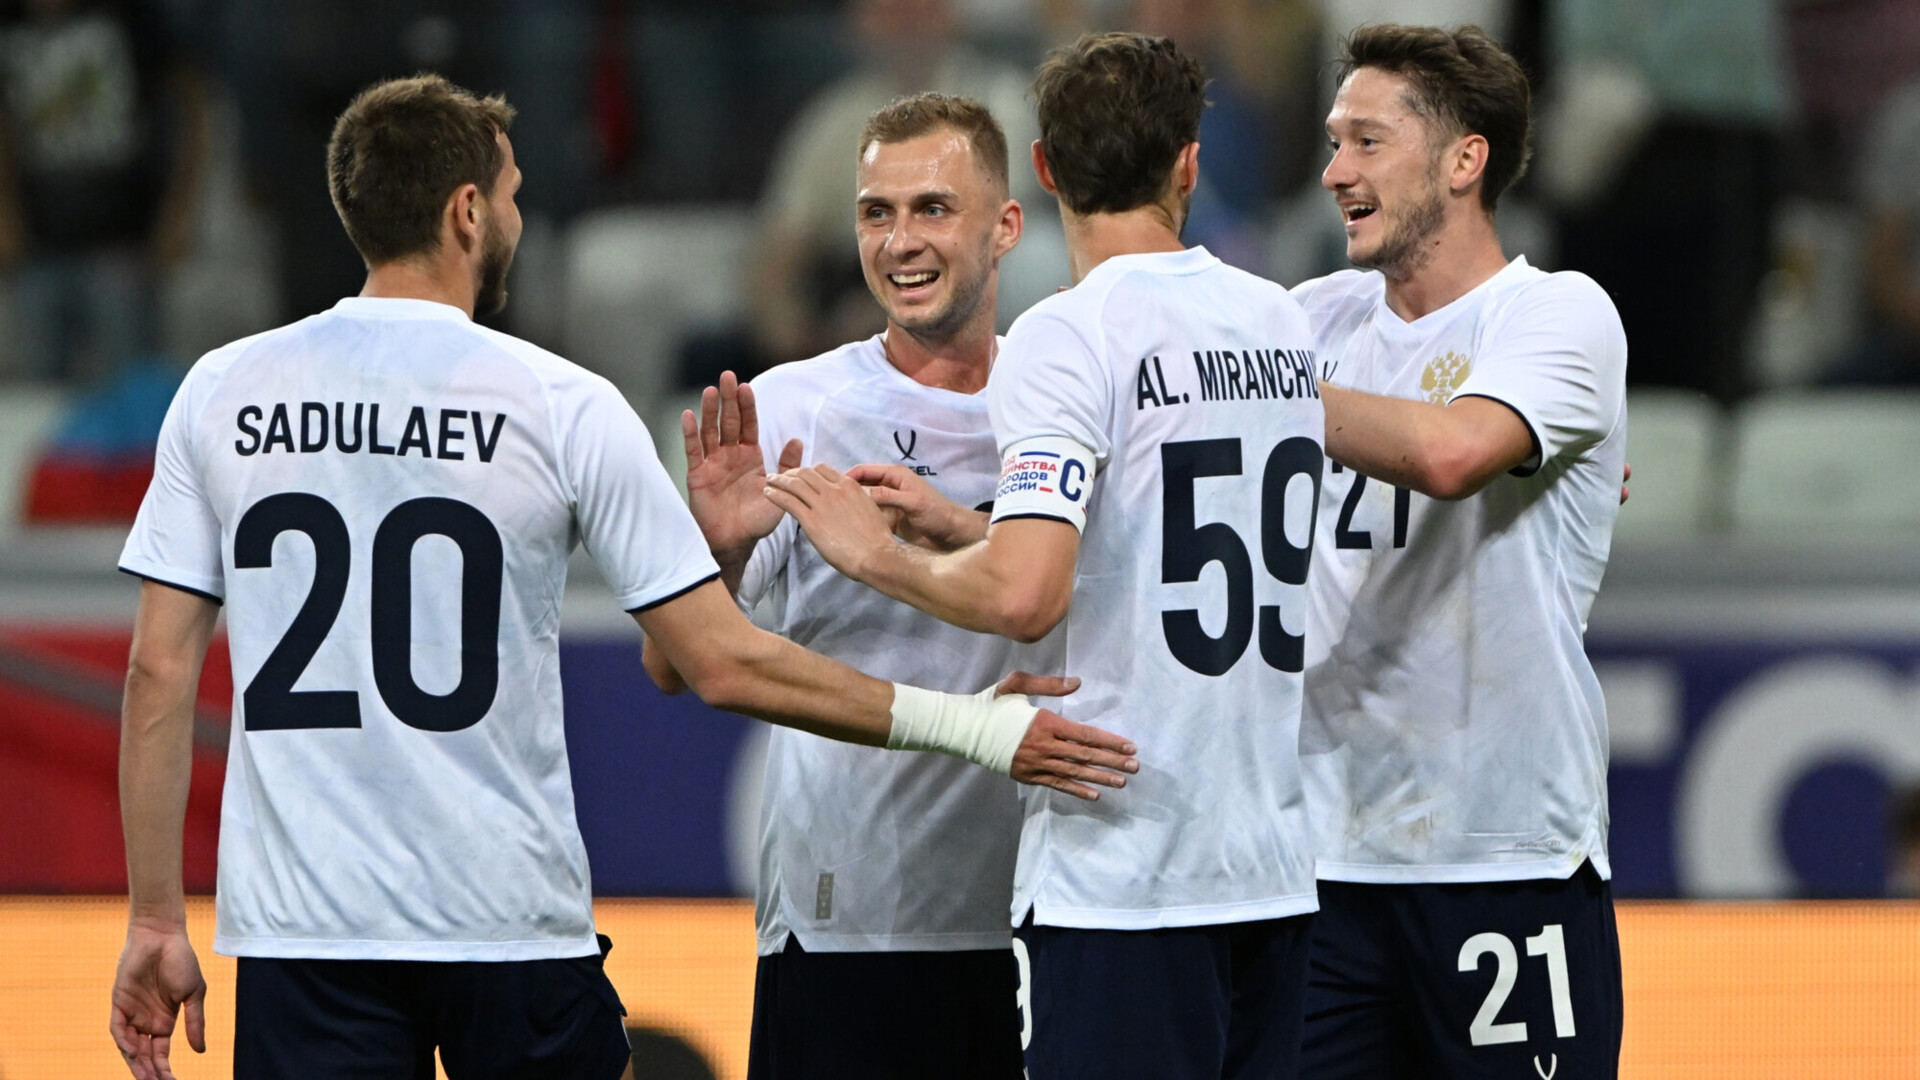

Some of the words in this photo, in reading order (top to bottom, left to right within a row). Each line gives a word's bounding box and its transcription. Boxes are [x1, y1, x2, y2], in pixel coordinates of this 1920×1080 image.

[235, 401, 507, 463] SADULAEV
[1137, 355, 1190, 410] AL.
[1193, 348, 1319, 400] MIRANCHU
[1160, 435, 1324, 677] 59
[1331, 457, 1412, 550] 21
[233, 491, 504, 733] 20
[1457, 923, 1576, 1047] 21
